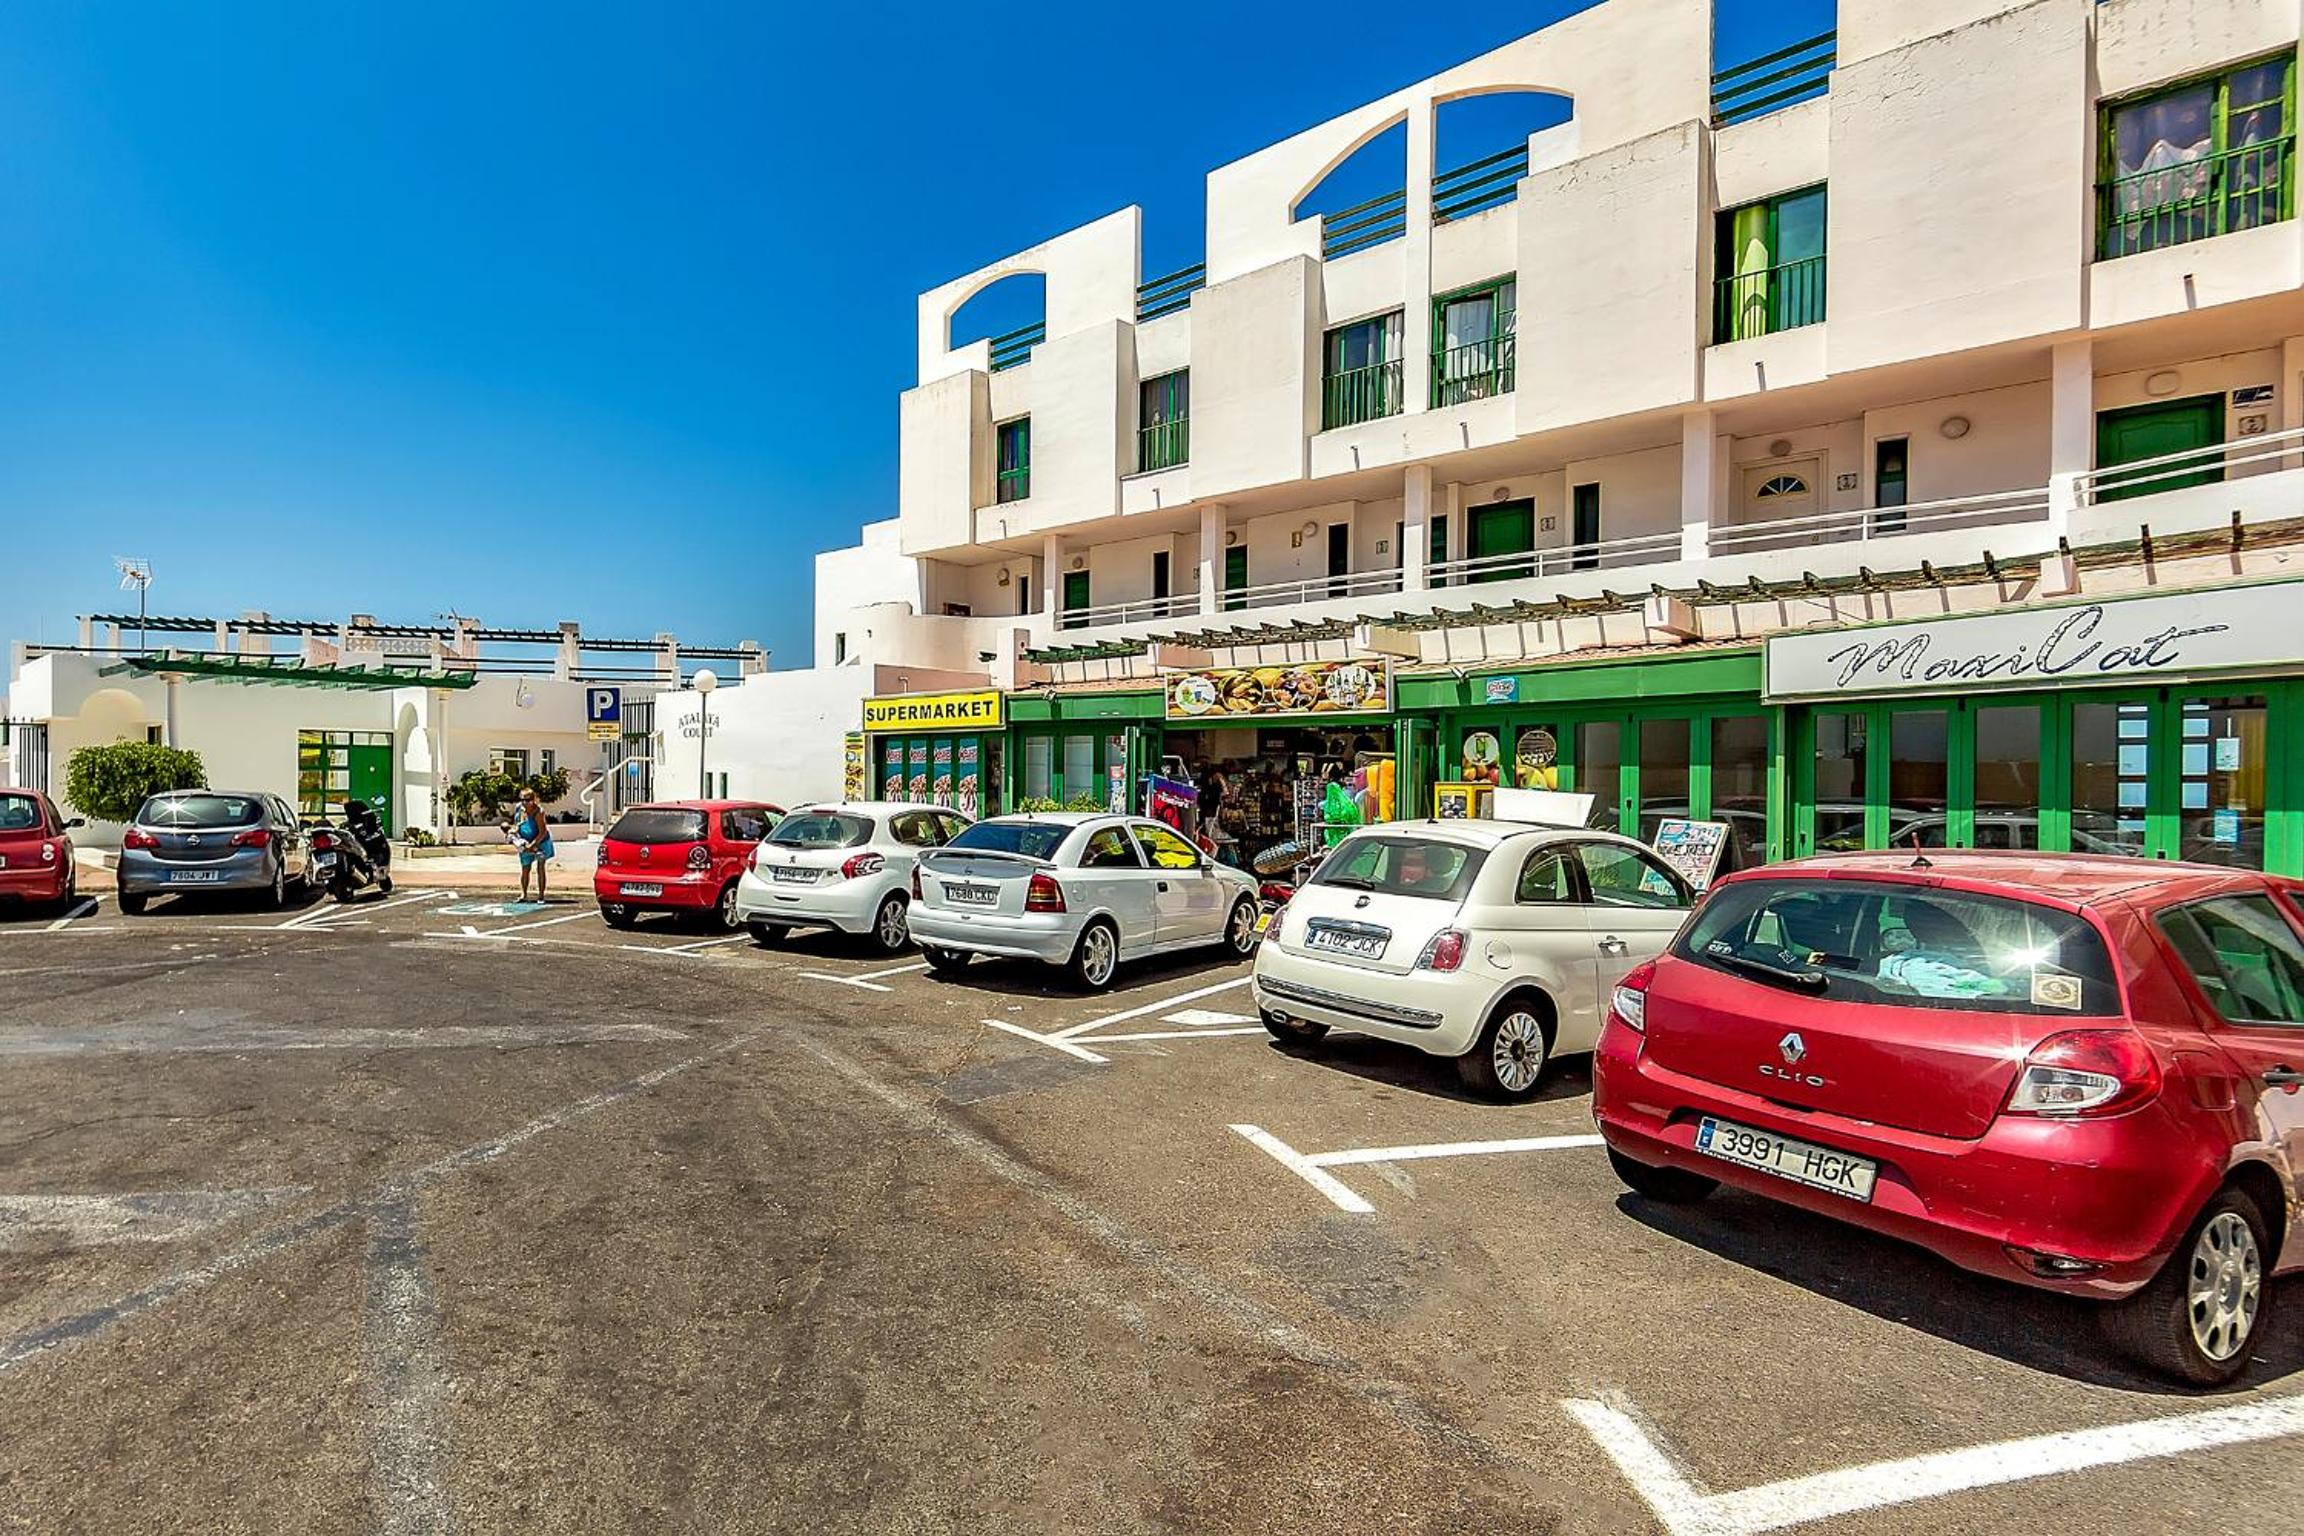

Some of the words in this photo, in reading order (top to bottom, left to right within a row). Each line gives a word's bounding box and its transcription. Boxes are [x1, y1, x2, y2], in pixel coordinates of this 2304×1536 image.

[593, 690, 614, 718] P
[866, 700, 993, 722] SUPERMARKET
[1758, 1065, 1825, 1087] CLIO
[1721, 1128, 1785, 1166] 3991
[1803, 1150, 1861, 1188] HGK
